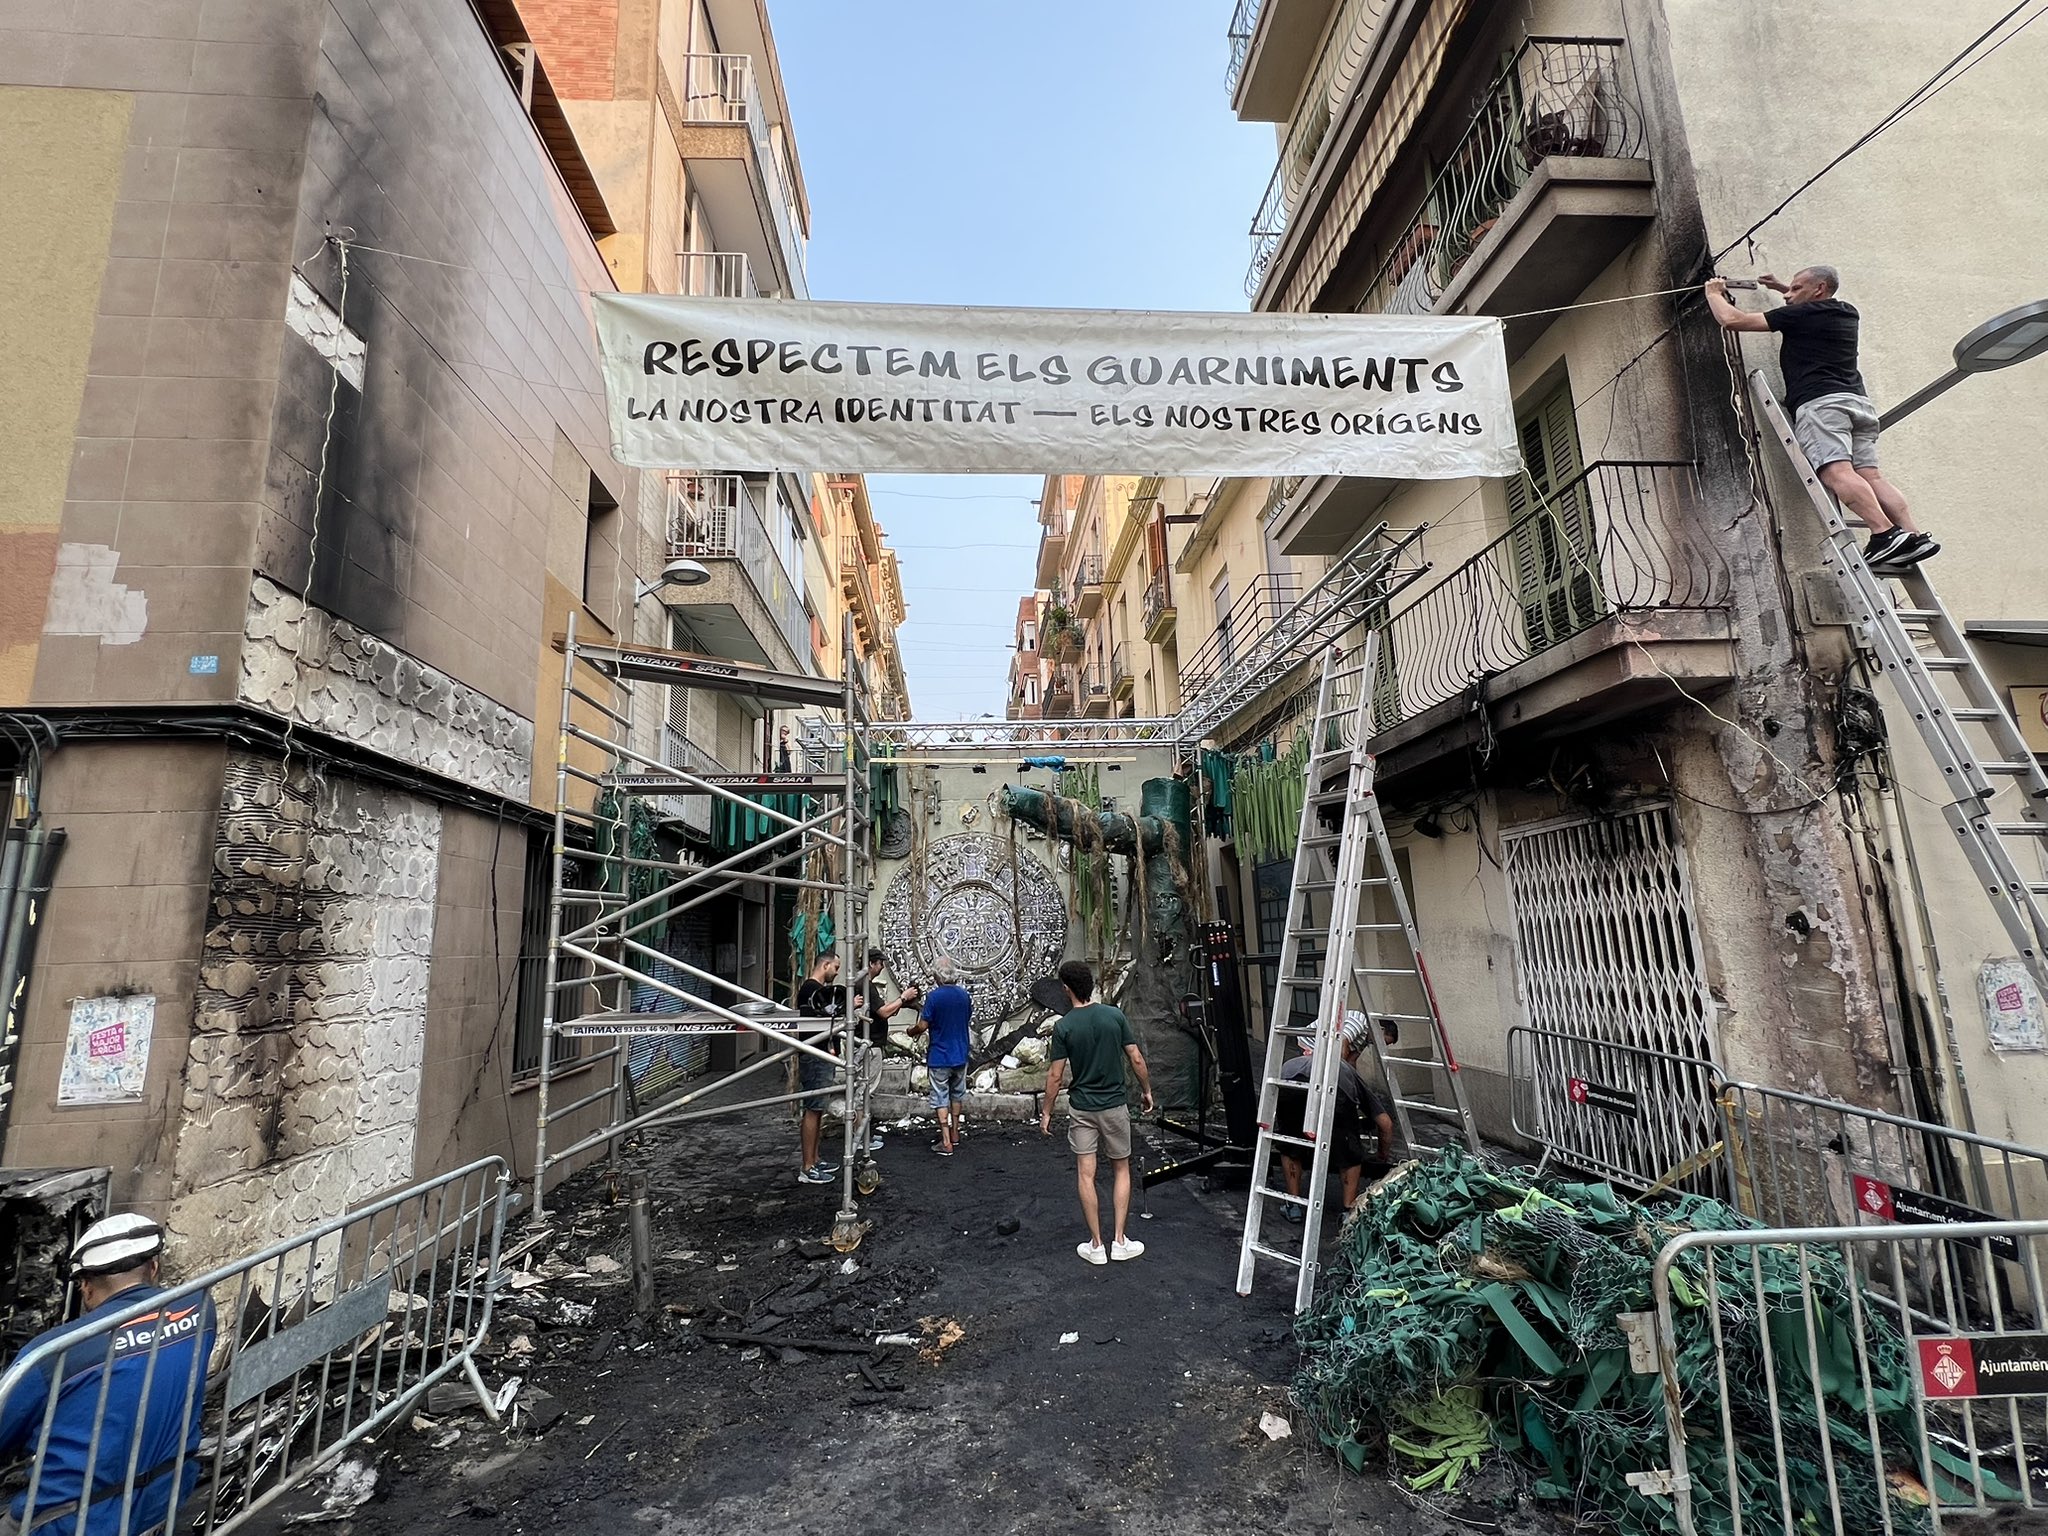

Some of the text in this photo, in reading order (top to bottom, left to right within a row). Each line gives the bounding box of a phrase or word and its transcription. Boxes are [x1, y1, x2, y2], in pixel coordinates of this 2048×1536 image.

[643, 338, 1464, 394] RESPECTEM ELS GUARNIMENTS
[627, 397, 669, 422] LA
[678, 398, 824, 425] NOSTRA
[834, 397, 1022, 425] IDENTITAT
[1090, 404, 1155, 428] ELS
[1164, 404, 1322, 437] NOSTRES
[1330, 406, 1483, 437] ORÍGENS
[623, 655, 731, 675] INSTANT SPAN
[91, 1027, 117, 1041] FESTA
[575, 1026, 621, 1034] AIRMAX
[676, 1023, 737, 1031] INSTANT
